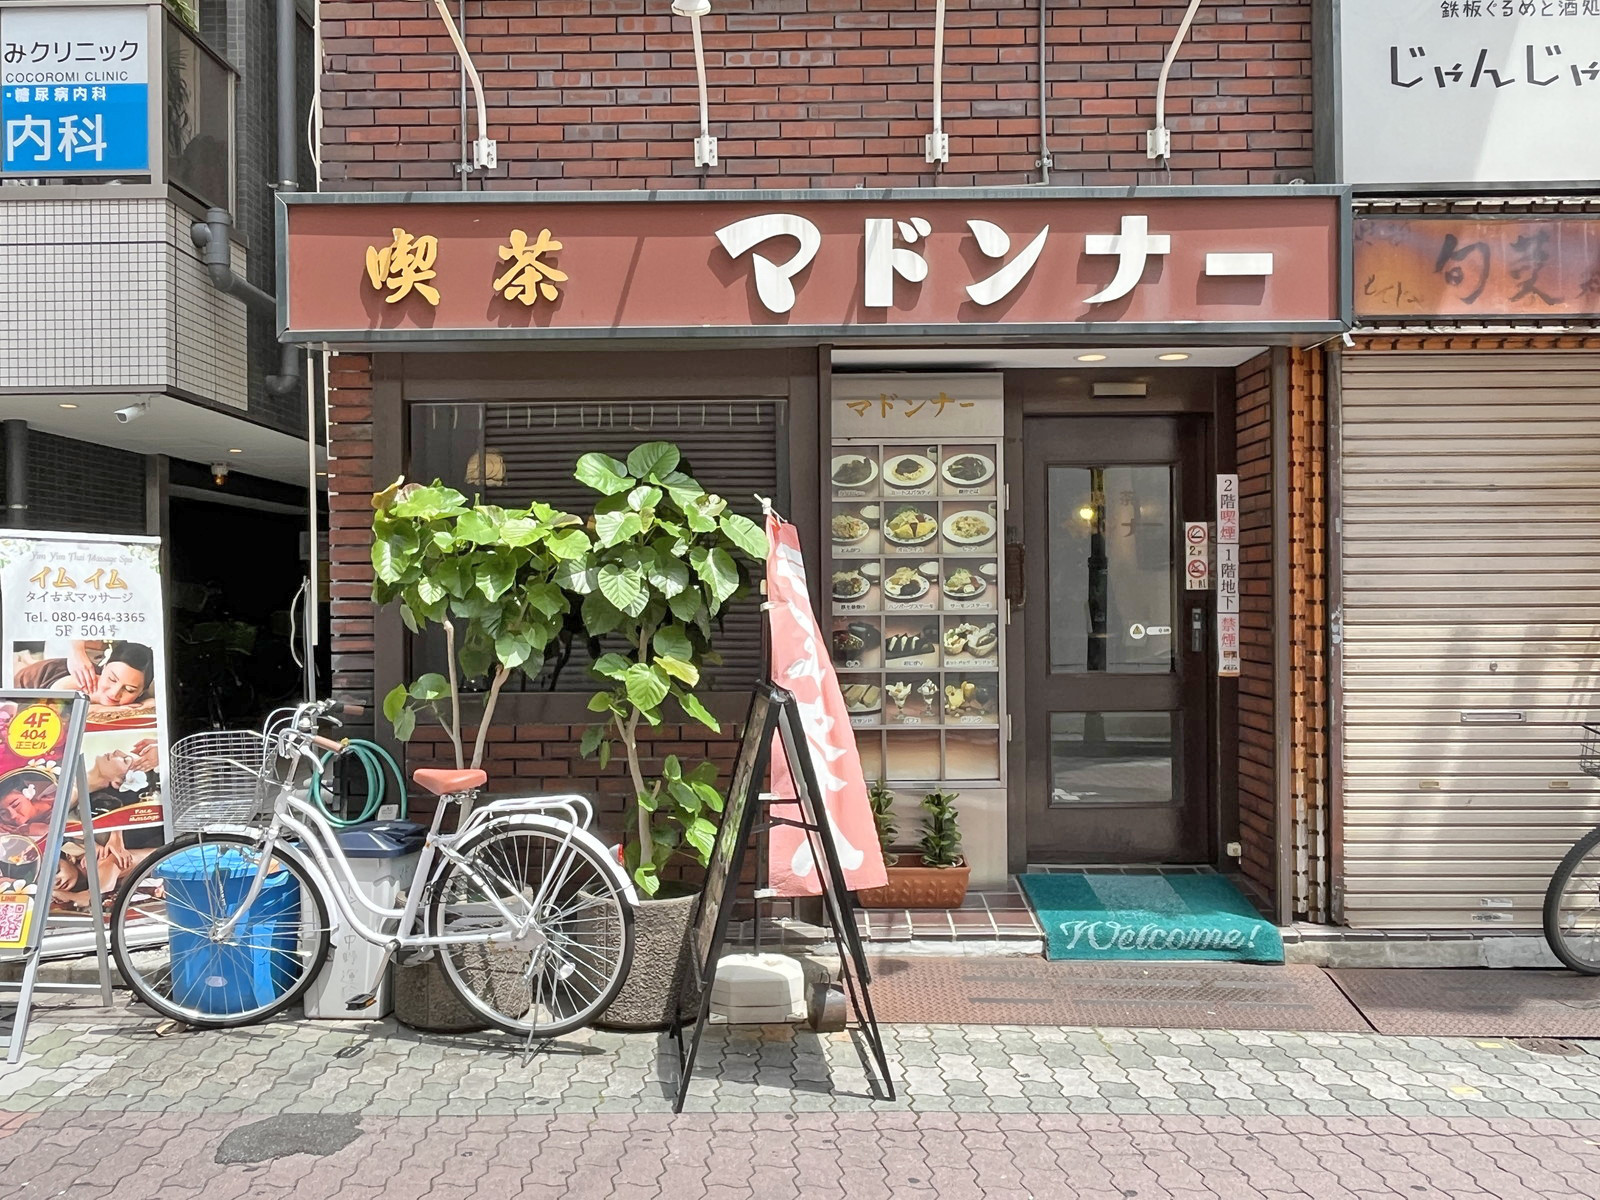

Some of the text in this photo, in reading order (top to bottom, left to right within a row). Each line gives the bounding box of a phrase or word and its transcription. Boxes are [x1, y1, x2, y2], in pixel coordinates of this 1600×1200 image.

[4, 41, 138, 63] みクリニック
[6, 71, 128, 83] COCOROMI CLINIC
[1390, 45, 1600, 88] じゃんじゃ
[6, 114, 107, 161] 内科
[365, 212, 1274, 314] 喫茶 マドンナー
[846, 391, 974, 418] マドンナー
[29, 566, 128, 590] イム イム
[26, 591, 133, 603] タイ古式マッサージ
[24, 612, 146, 622] Tel. 080-9464-3365
[55, 625, 73, 637] 5F
[24, 712, 51, 728] 4F
[20, 729, 47, 740] 404
[1060, 920, 1262, 949] Welcome!
